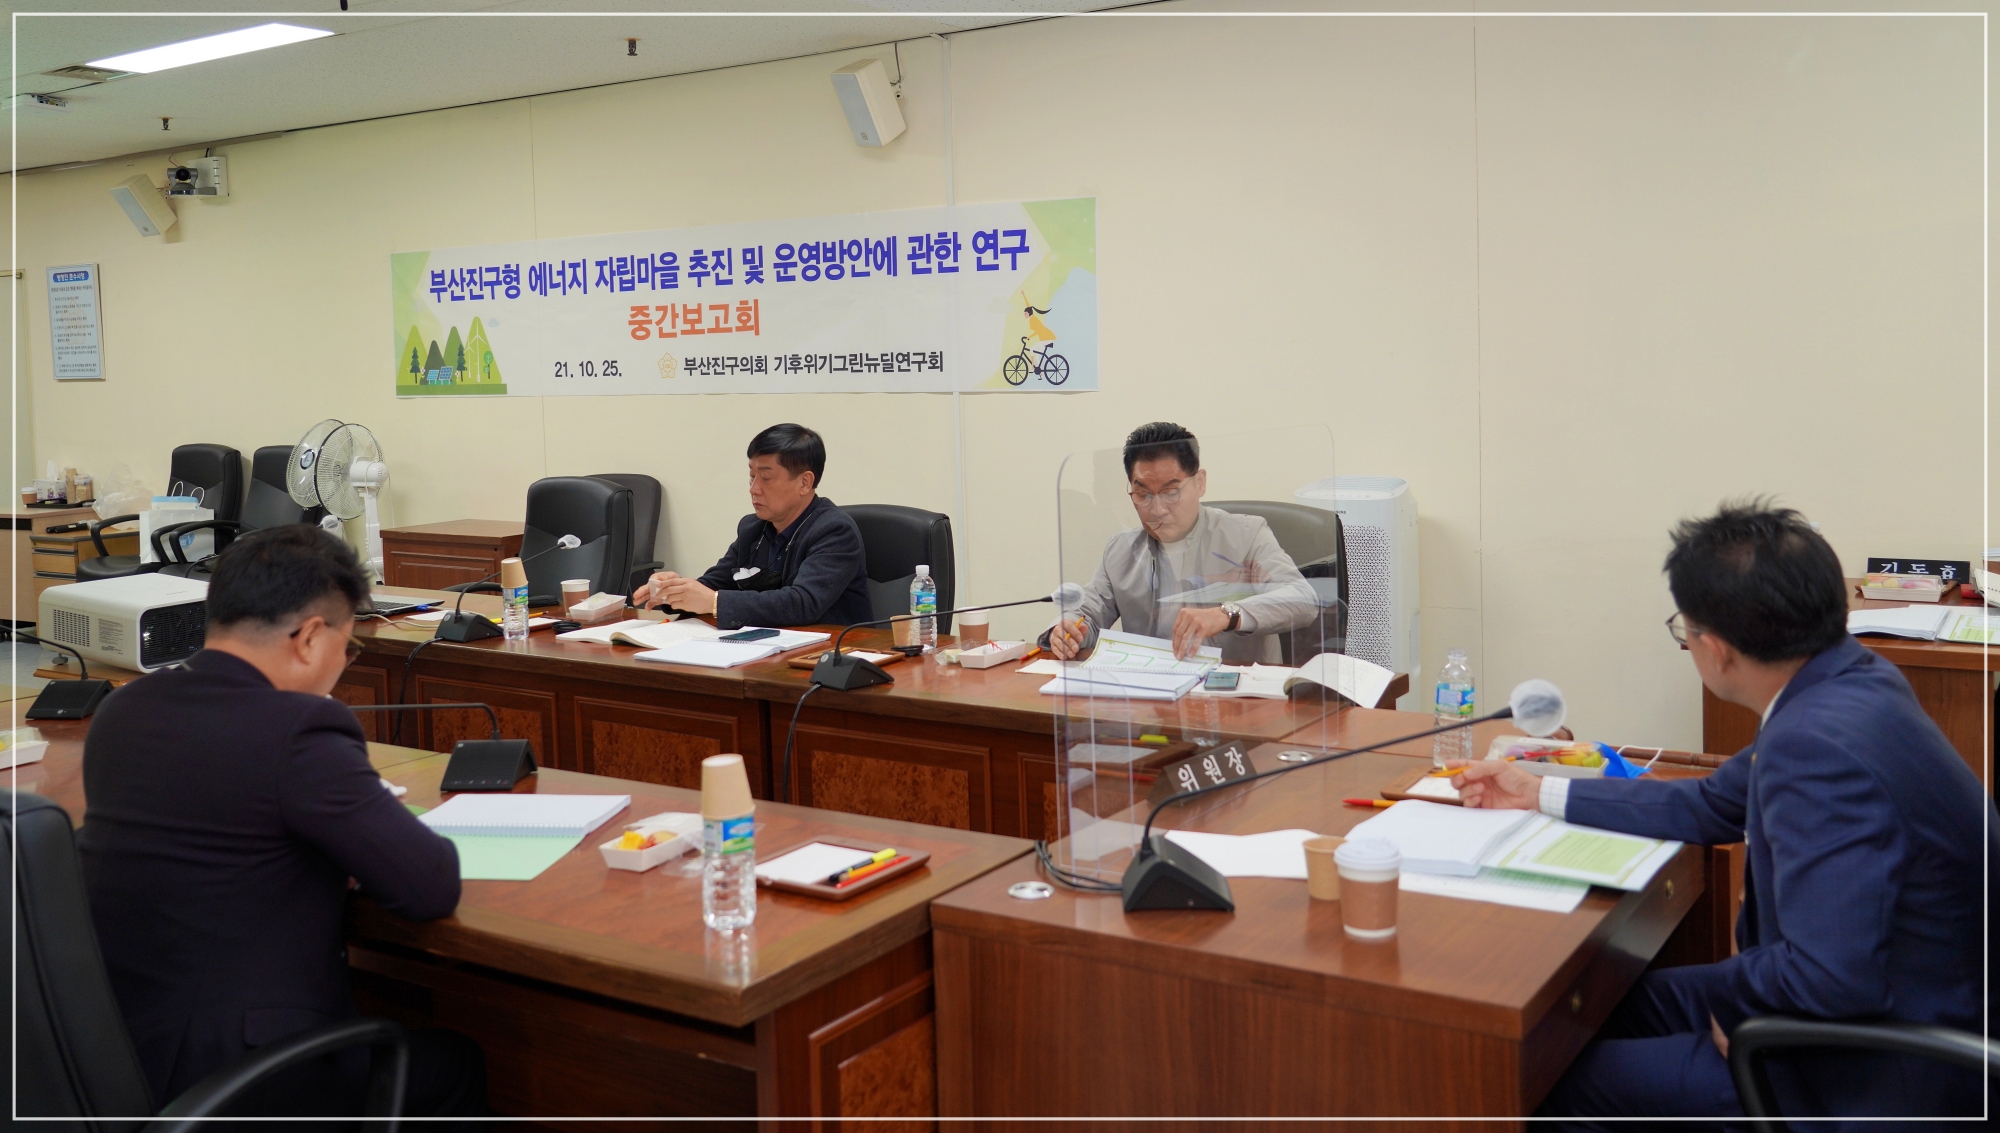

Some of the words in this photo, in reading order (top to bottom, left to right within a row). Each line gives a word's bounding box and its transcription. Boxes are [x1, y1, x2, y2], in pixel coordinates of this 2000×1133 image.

[429, 263, 521, 303] 부산진구형
[528, 258, 588, 297] 에너지
[594, 251, 681, 293] 자립마을
[687, 247, 734, 288] 추진
[741, 245, 765, 285] 및
[772, 235, 898, 283] 운영방안에
[906, 231, 962, 275] 관한
[971, 228, 1030, 272] 연구
[627, 298, 761, 341] 중간보고회
[554, 361, 574, 378] 21.
[578, 360, 598, 378] 10.
[602, 359, 623, 377] 25.
[683, 354, 768, 377] 부산진구의회
[773, 350, 944, 375] 기후위기그린뉴딜연구회
[1178, 746, 1246, 792] 위원장
